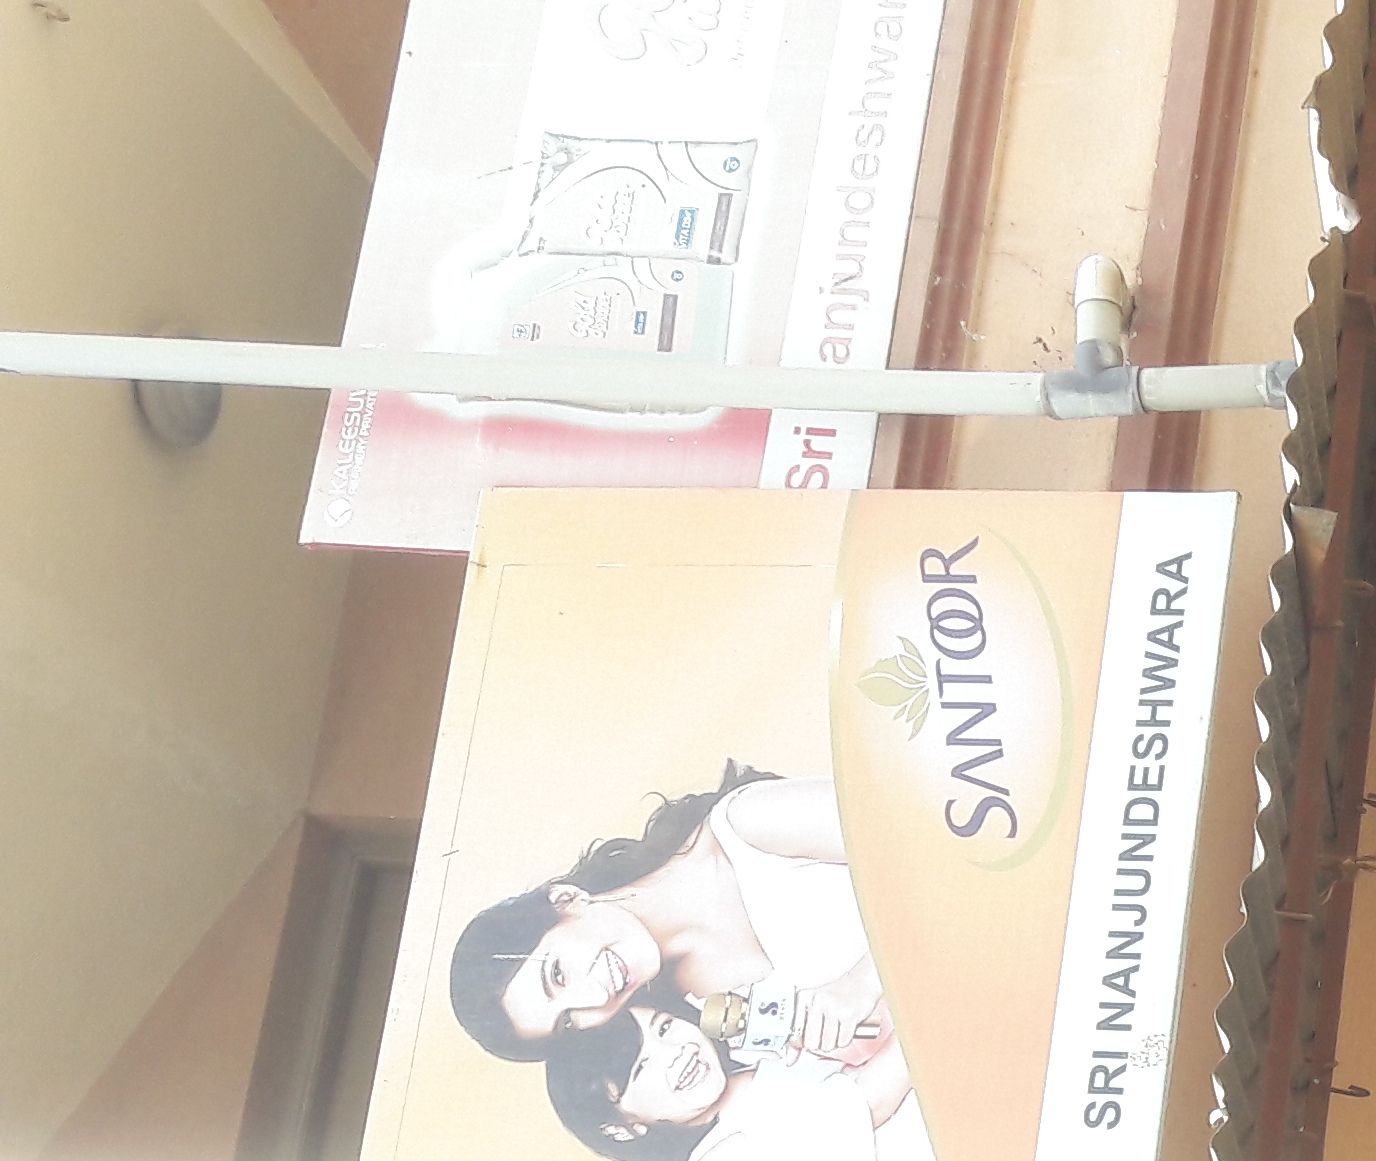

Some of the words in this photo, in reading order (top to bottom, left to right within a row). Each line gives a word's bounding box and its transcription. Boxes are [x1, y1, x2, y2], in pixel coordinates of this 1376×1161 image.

[783, 426, 837, 490] Sri
[816, 1, 906, 365] anjundeshwar
[328, 389, 366, 495] KALEESU
[919, 536, 1018, 840] SANTOOR
[1096, 551, 1193, 1032] NANJUNDESHWARA
[1084, 1050, 1129, 1130] SRI
